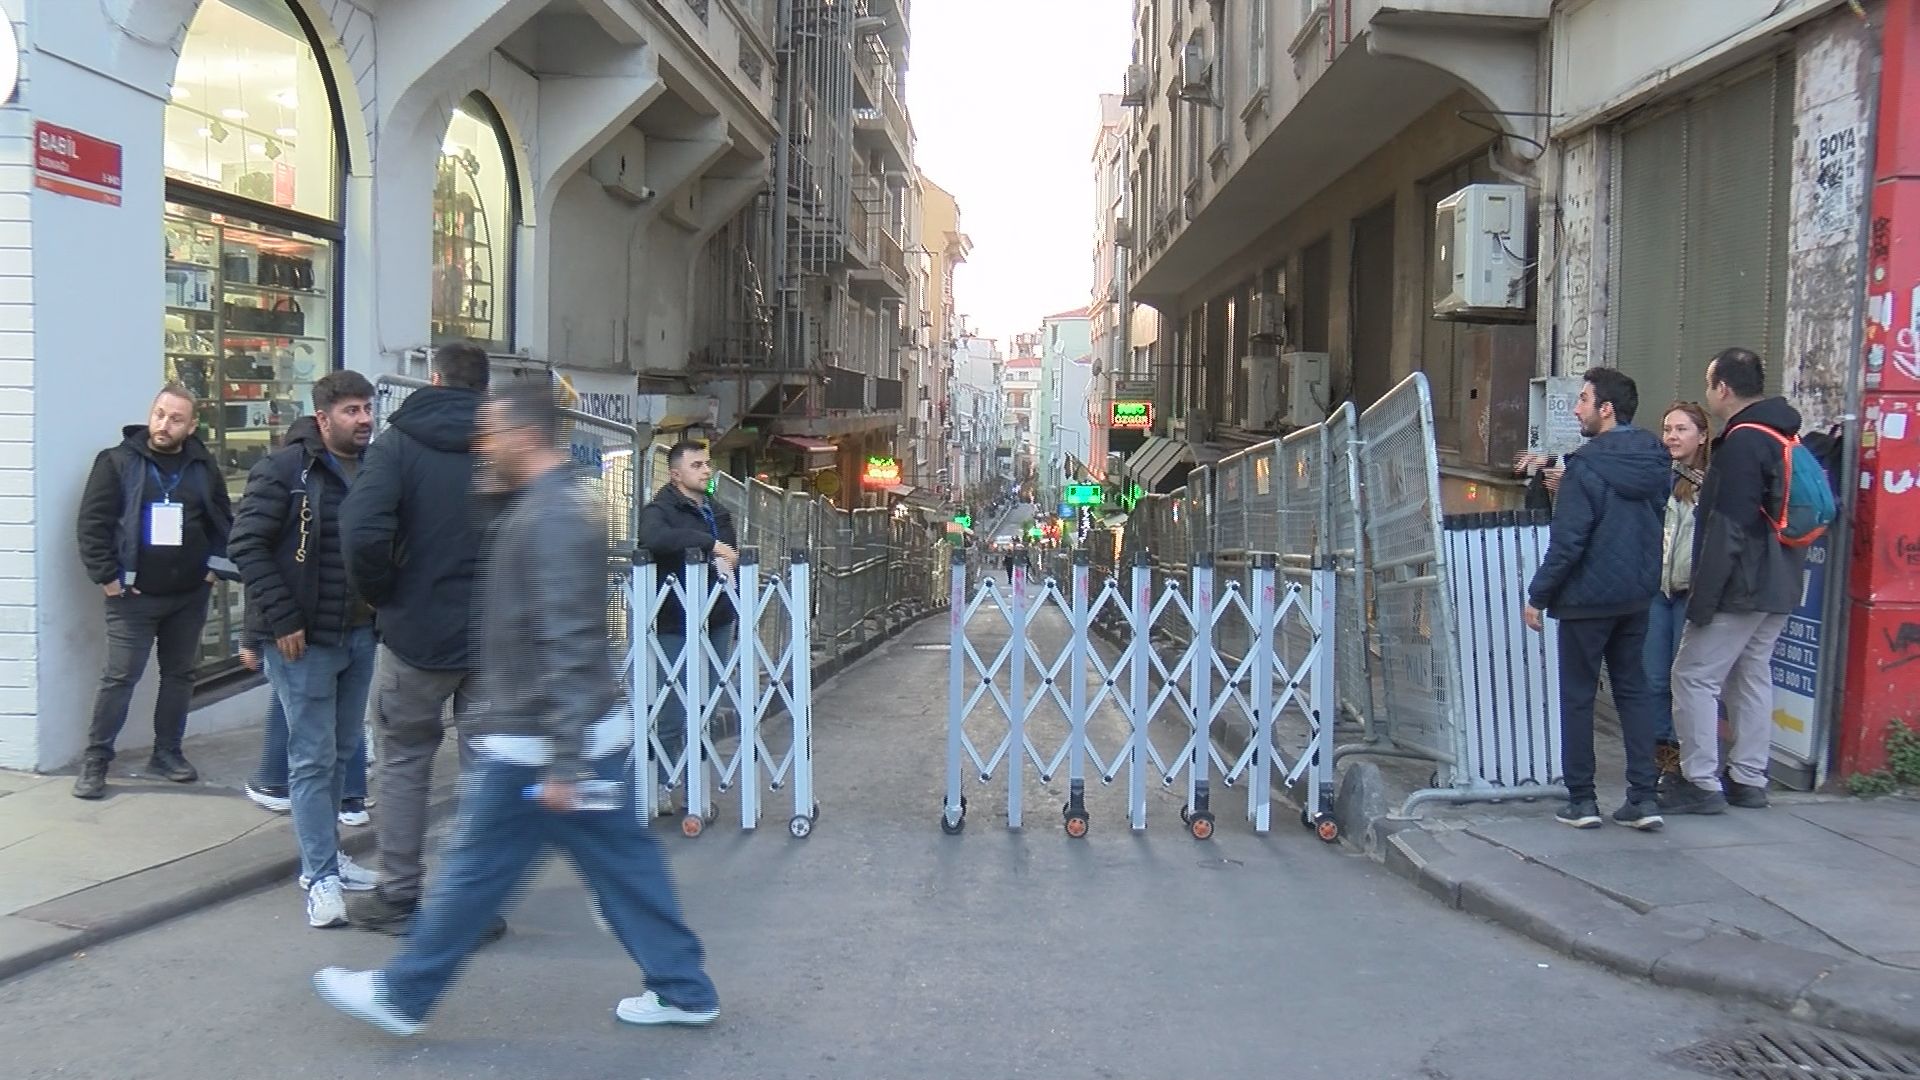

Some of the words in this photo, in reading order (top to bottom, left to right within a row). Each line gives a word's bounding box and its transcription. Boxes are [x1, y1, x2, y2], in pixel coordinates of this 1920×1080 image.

[1820, 127, 1856, 160] BOYA
[1806, 625, 1817, 641] TL
[1804, 649, 1816, 666] TL
[1802, 676, 1815, 693] TL
